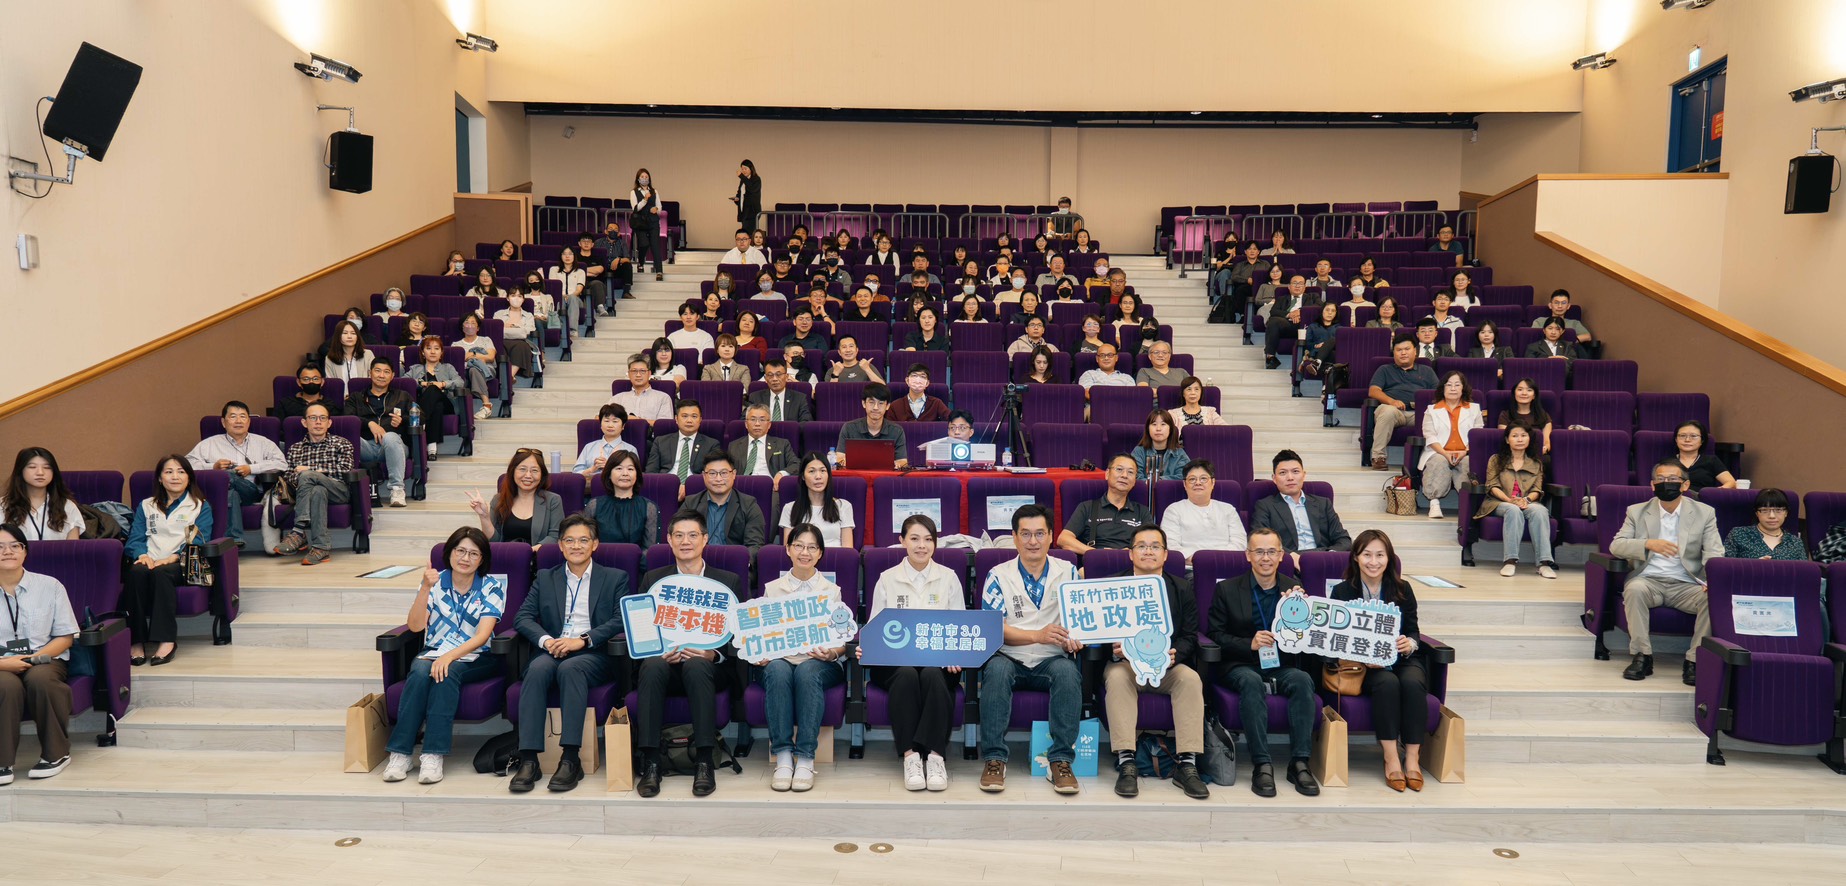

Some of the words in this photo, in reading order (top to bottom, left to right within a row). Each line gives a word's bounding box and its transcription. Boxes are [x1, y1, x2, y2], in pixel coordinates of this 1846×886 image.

[658, 585, 730, 611] 手機就是
[1069, 584, 1154, 605] 新竹市政府
[653, 604, 727, 636] 謄本機
[736, 594, 832, 632] 智慧地政
[1069, 600, 1163, 632] 地政處
[1311, 601, 1397, 637] 5D立體
[741, 621, 831, 657] 竹市領航
[915, 637, 987, 651] 幸福宜居網
[1307, 629, 1393, 661] 實價登錄
